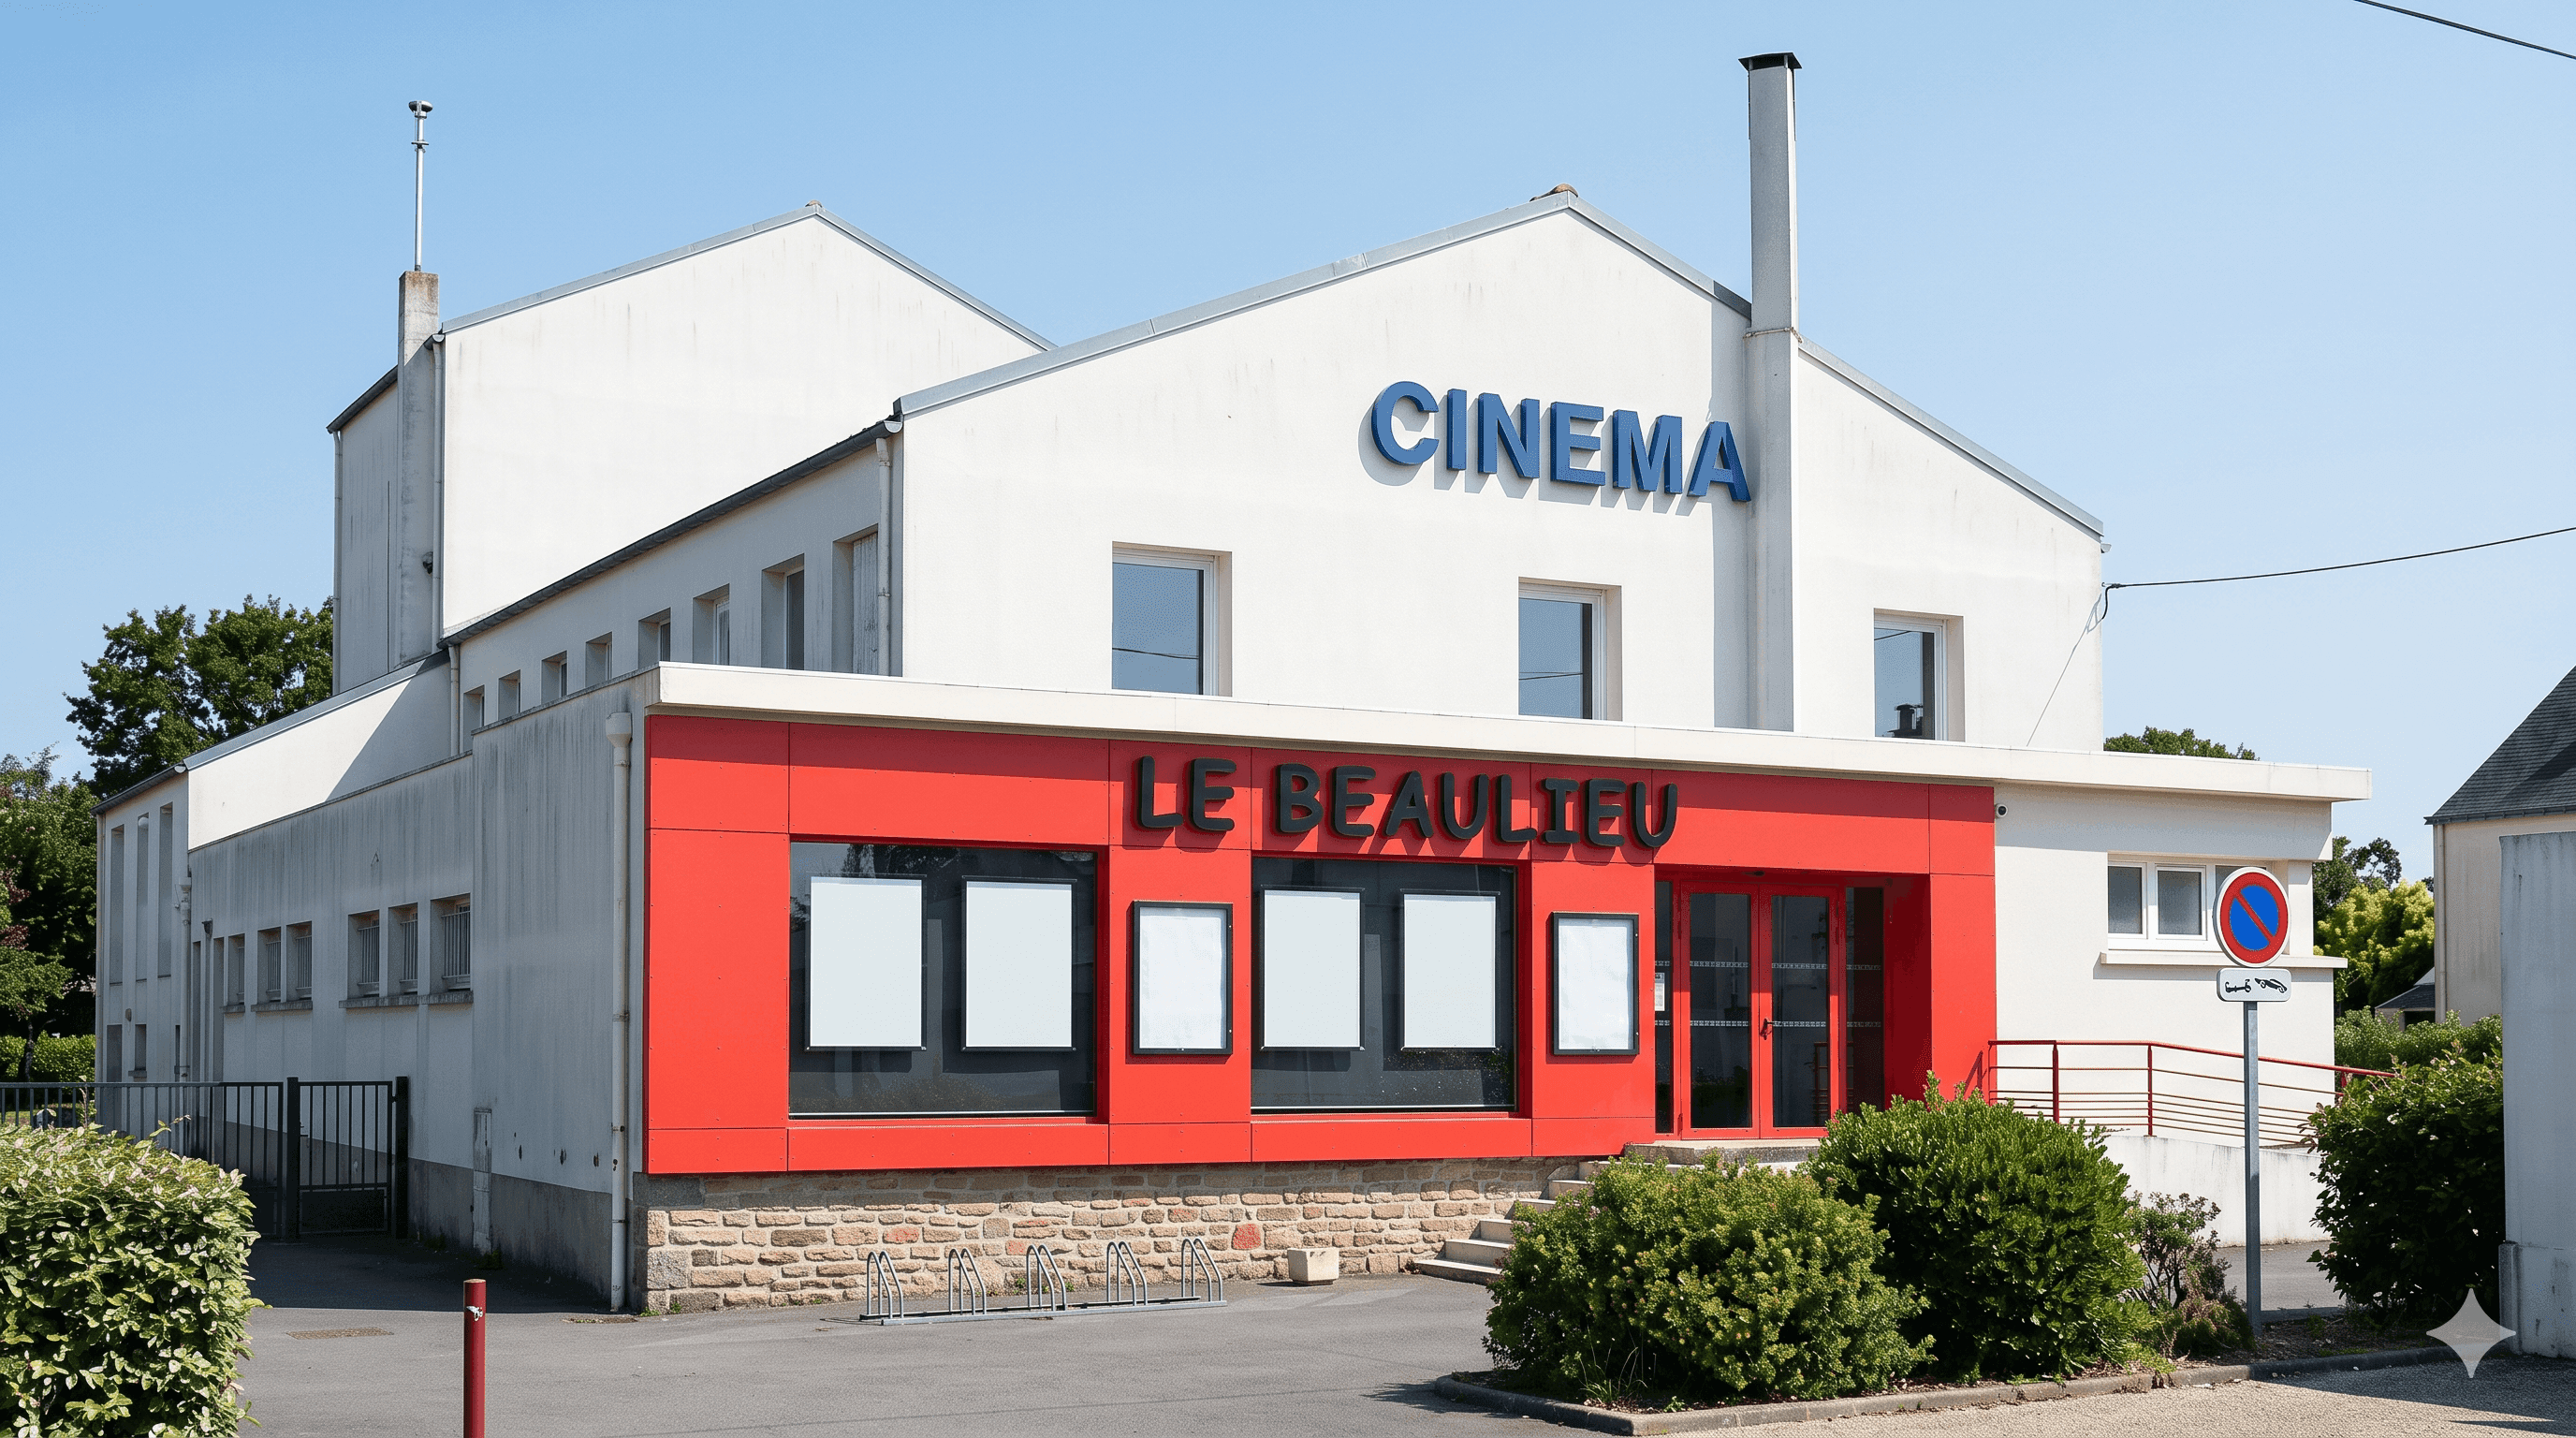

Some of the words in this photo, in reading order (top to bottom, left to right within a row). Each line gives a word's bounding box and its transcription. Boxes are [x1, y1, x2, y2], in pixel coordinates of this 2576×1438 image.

[1371, 381, 1751, 503] CINEMA
[1137, 755, 1237, 832] LE
[1276, 762, 1678, 848] BEAULIEU
